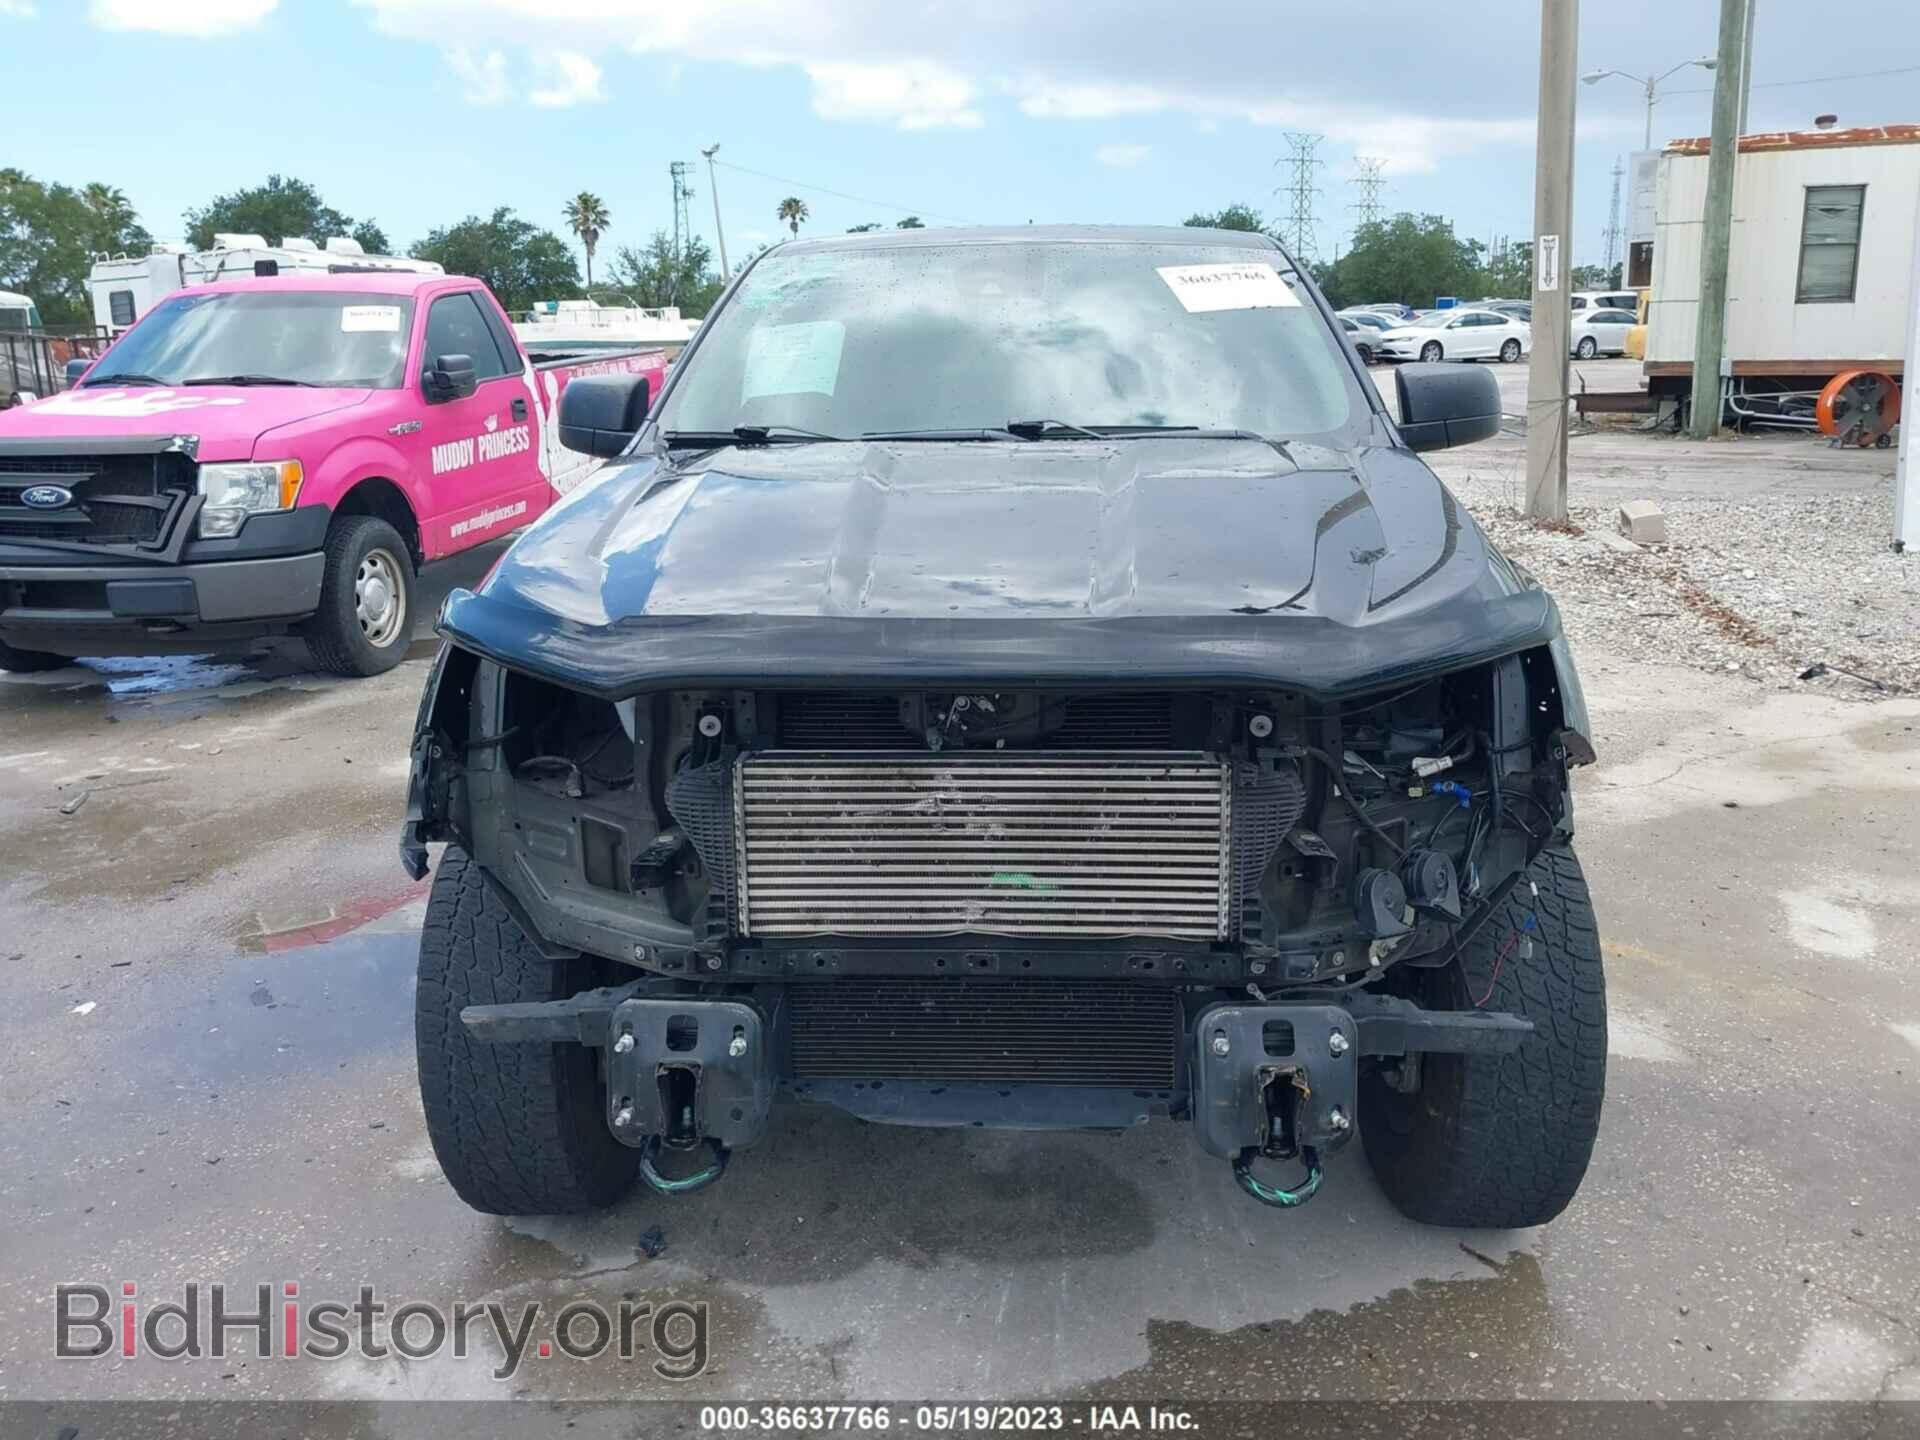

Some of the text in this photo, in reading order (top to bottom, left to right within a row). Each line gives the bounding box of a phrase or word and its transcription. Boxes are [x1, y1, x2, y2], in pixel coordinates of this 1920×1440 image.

[431, 425, 530, 475] MUDDY PRINCESS
[31, 490, 58, 503] Ford
